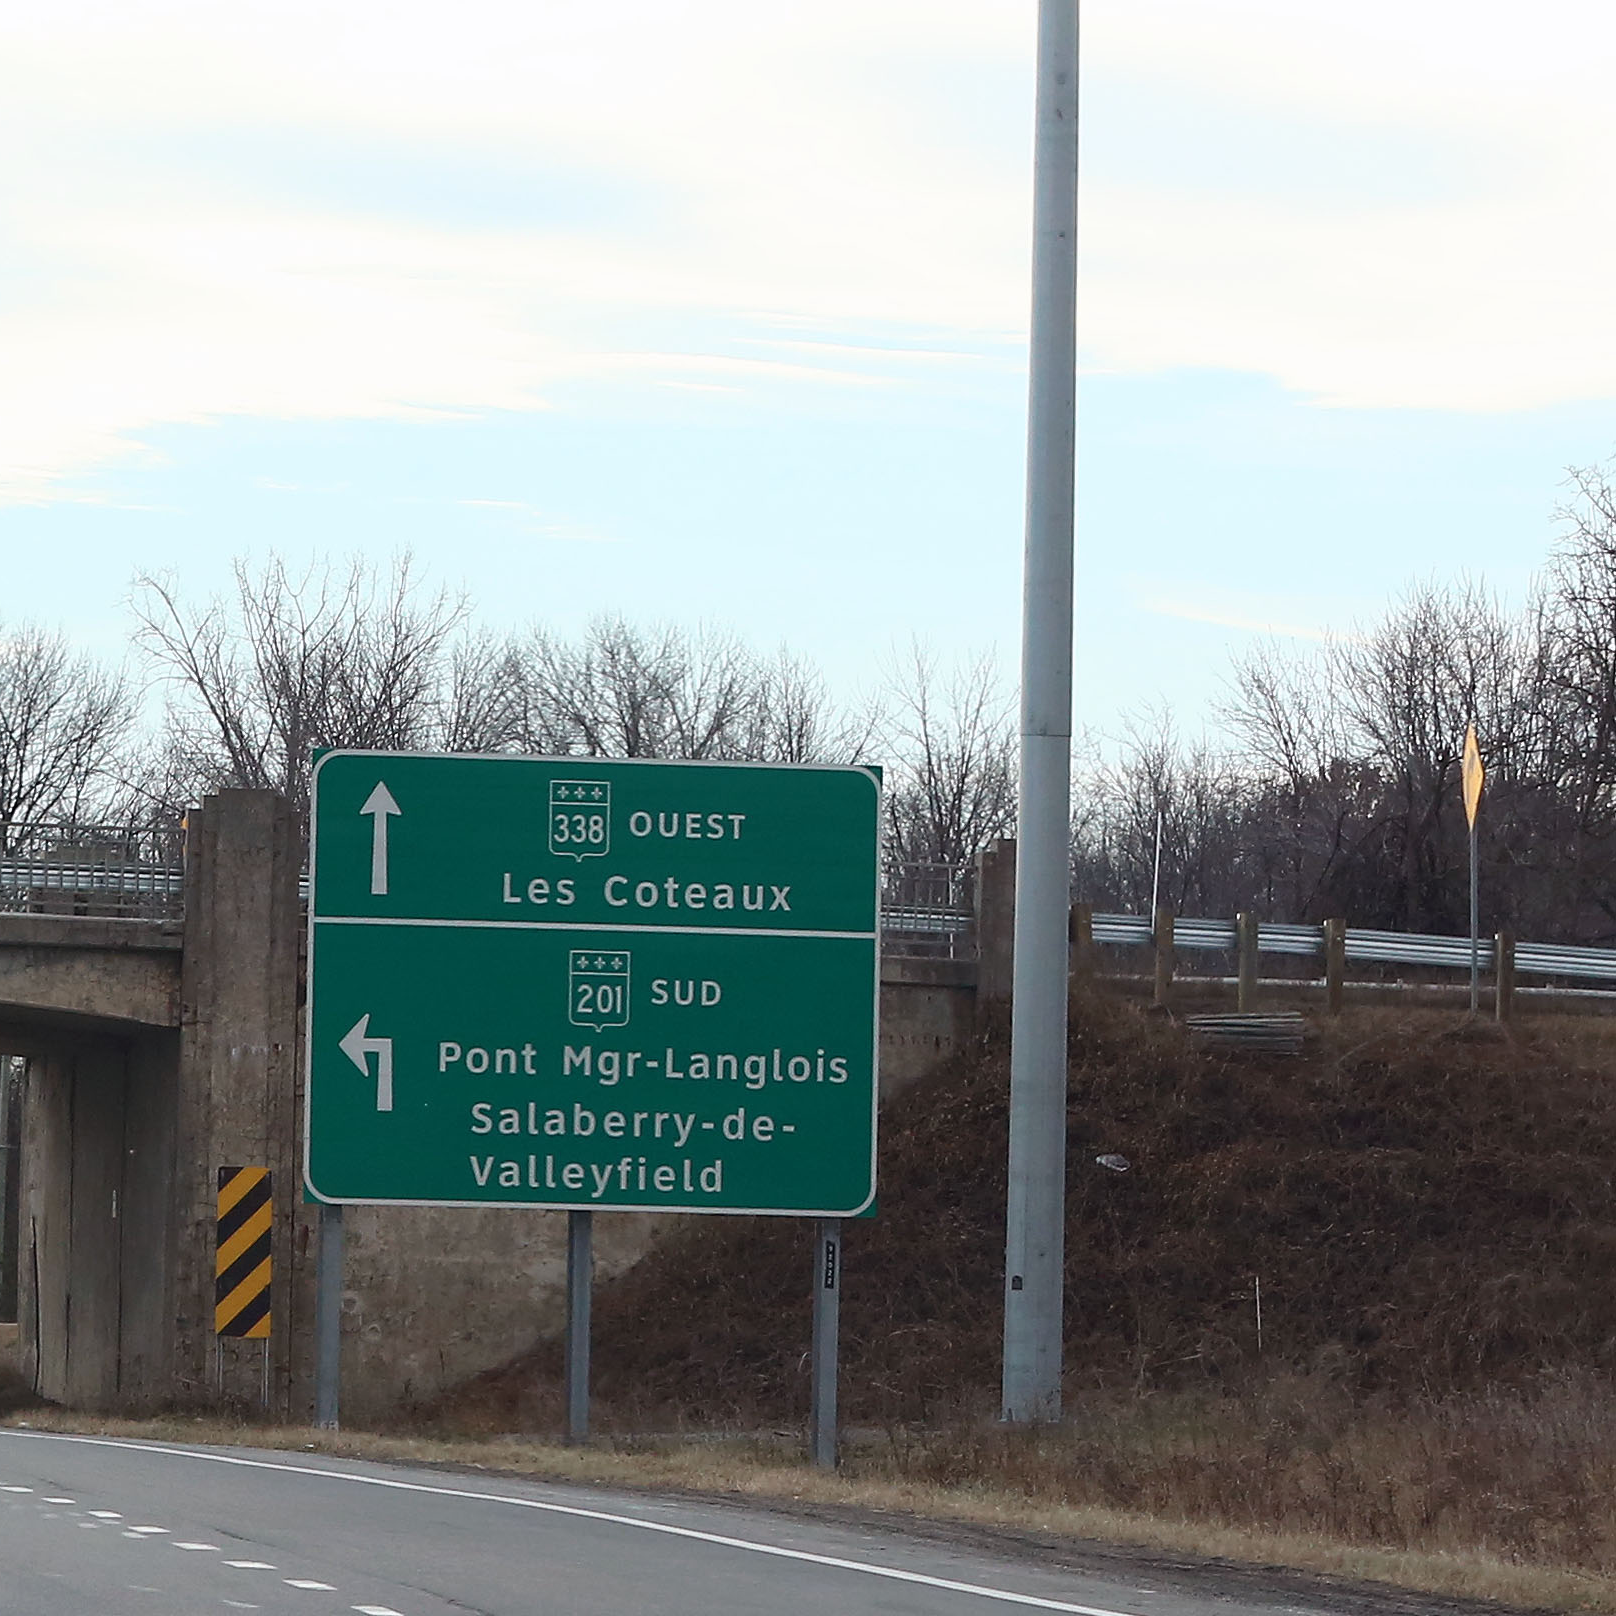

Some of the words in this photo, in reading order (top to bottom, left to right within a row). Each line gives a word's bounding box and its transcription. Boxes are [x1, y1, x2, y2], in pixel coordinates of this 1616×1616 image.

[554, 815, 603, 843] 338
[630, 812, 745, 839] OUEST
[504, 873, 574, 904] Les
[605, 876, 790, 910] Coteaux
[578, 985, 621, 1013] 201
[652, 980, 720, 1005] SUD
[440, 1043, 536, 1074] Pont
[564, 1046, 847, 1088] Mgr-Langlois
[472, 1103, 796, 1146] Salaberry-de-
[470, 1155, 722, 1198] Valleyfield
